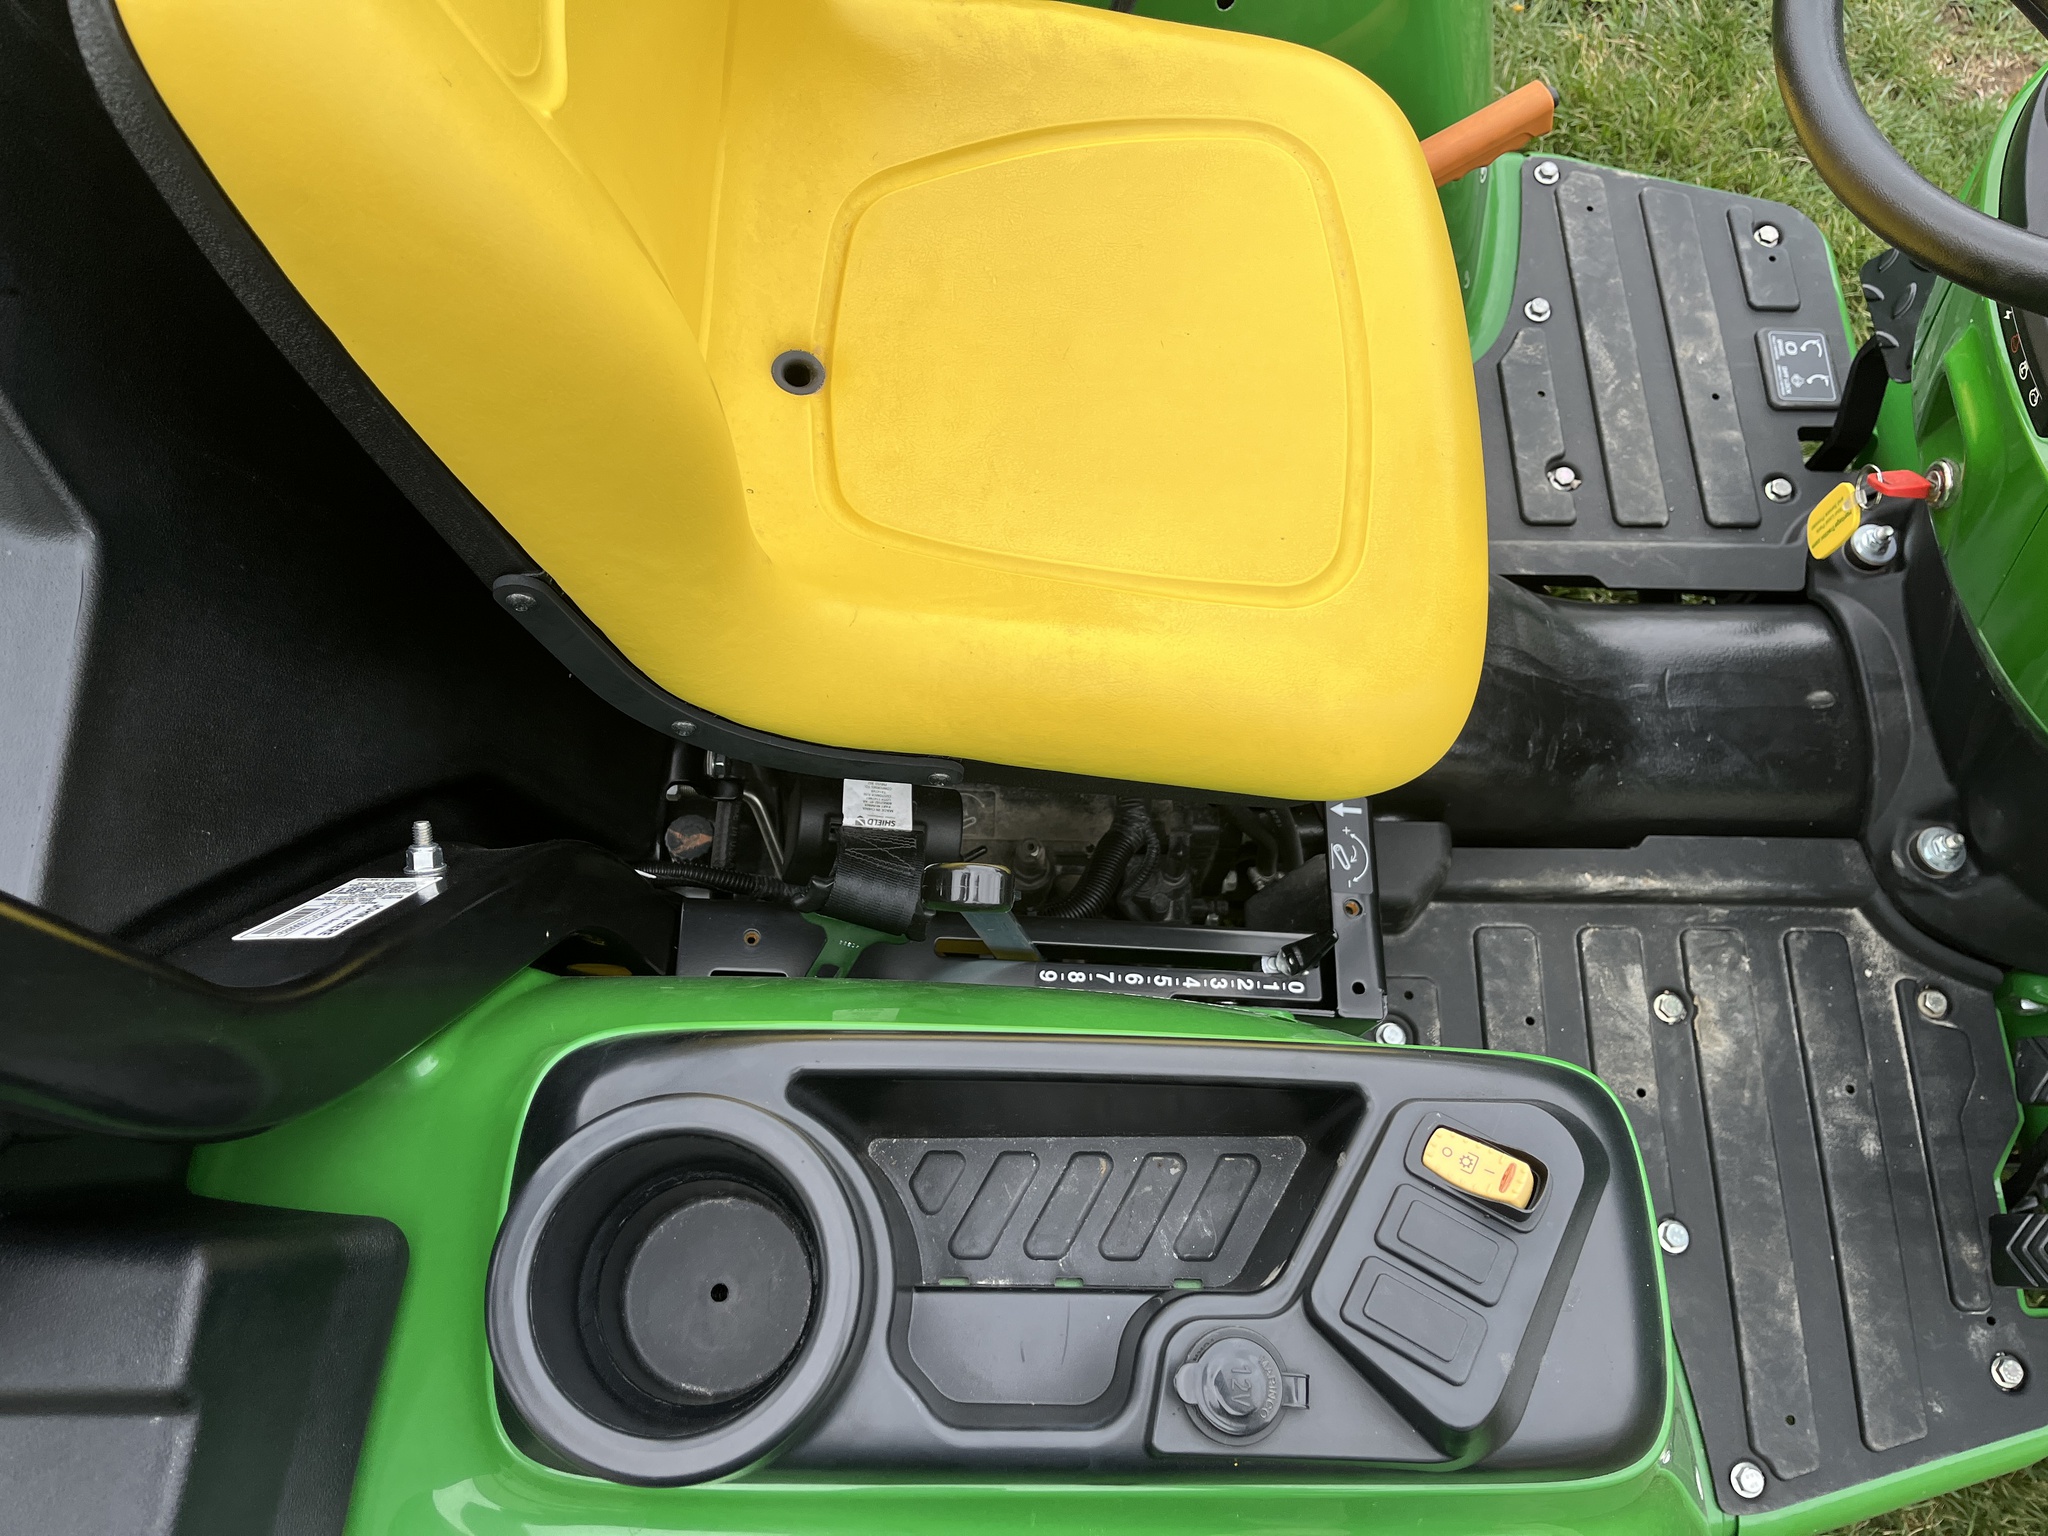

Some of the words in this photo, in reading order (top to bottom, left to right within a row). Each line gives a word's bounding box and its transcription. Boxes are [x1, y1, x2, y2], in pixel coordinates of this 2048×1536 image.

[867, 818, 896, 827] SHIELD
[1039, 970, 1058, 982] 9
[1067, 971, 1086, 983] 8
[1095, 971, 1115, 984] 7
[1124, 973, 1144, 985] 6
[1153, 975, 1173, 987] 5
[1182, 976, 1202, 989] 4
[1209, 977, 1229, 990] 3
[1236, 978, 1255, 991] 2
[1262, 981, 1280, 992] 1
[1287, 981, 1305, 994] 0
[1231, 1365, 1252, 1407] 12V
